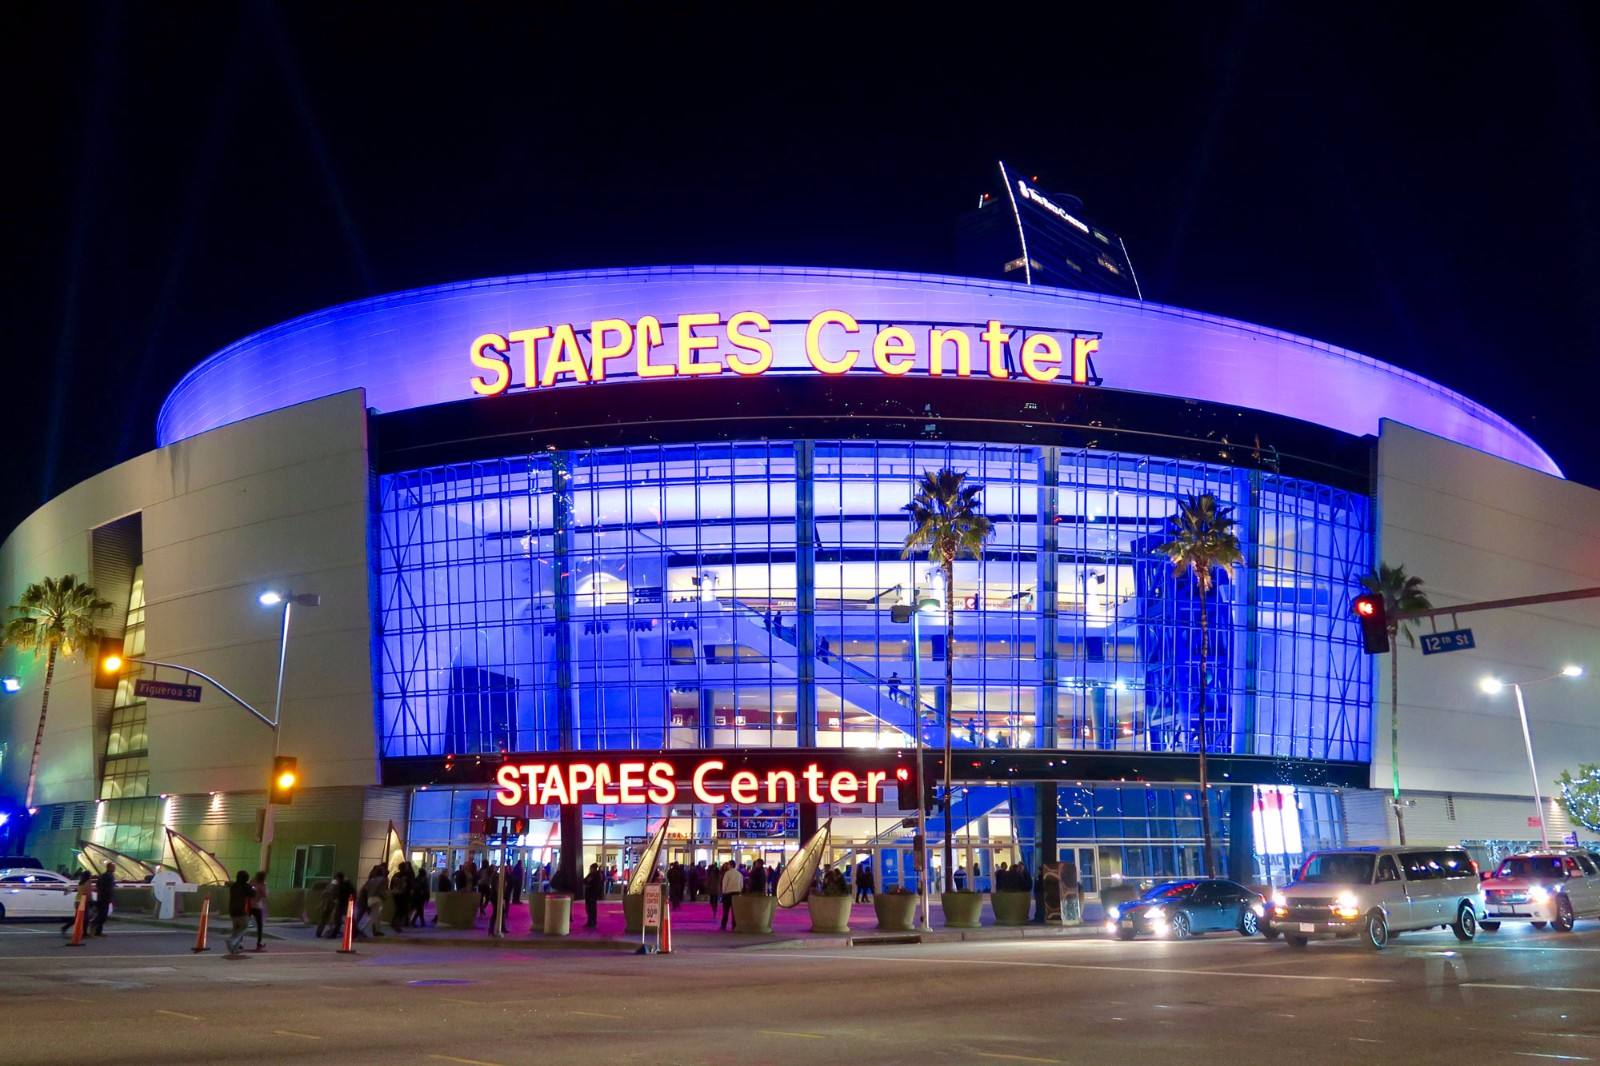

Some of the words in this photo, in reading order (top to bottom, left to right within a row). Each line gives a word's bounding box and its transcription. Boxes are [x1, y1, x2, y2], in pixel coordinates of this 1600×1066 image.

[470, 310, 773, 396] STAPLES
[804, 309, 1098, 384] Center
[1455, 634, 1469, 646] St
[139, 683, 183, 696] Figueroa
[185, 688, 197, 698] St
[496, 761, 676, 807] STAPLES
[692, 760, 886, 804] Center
